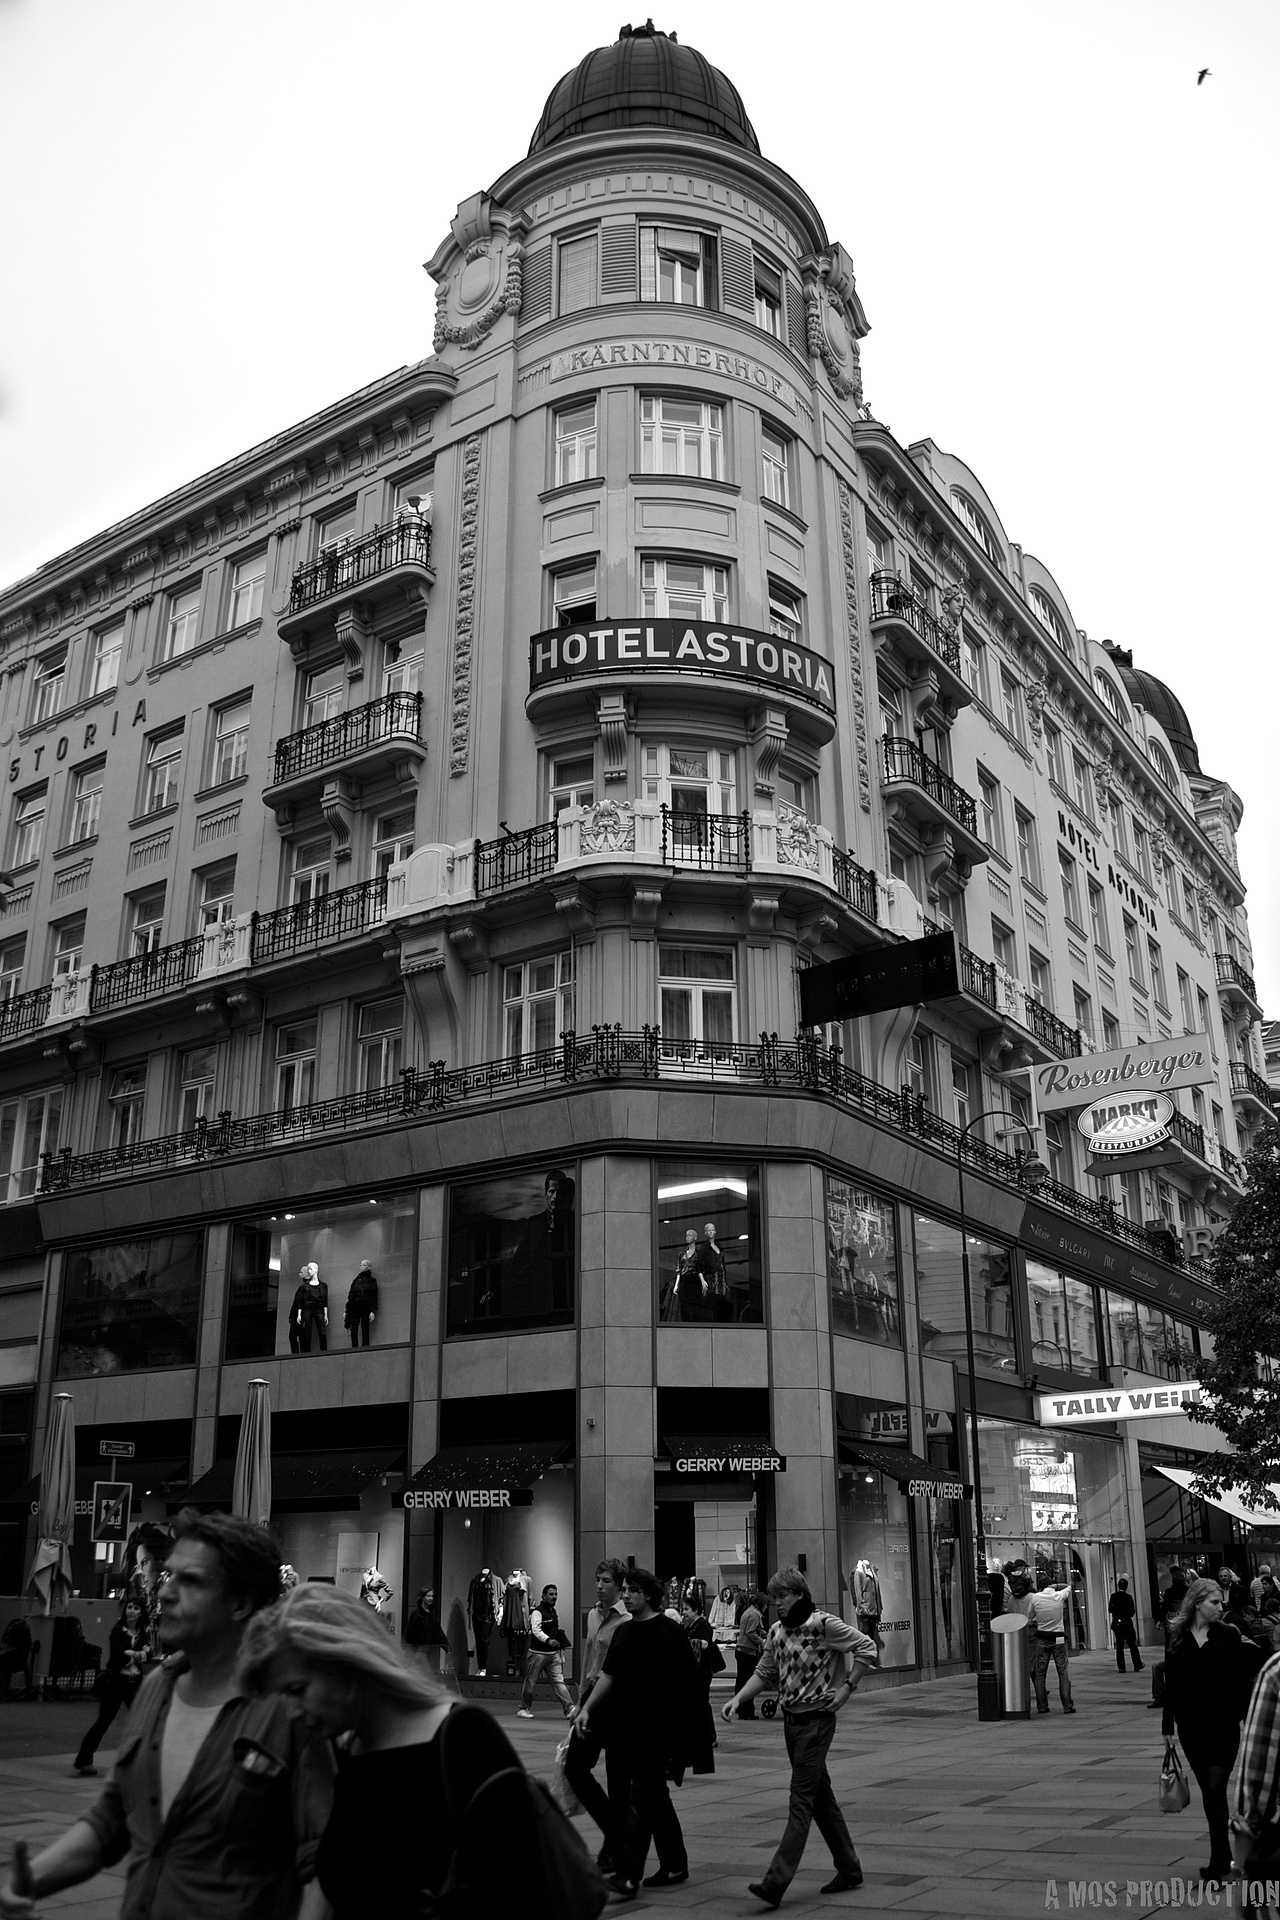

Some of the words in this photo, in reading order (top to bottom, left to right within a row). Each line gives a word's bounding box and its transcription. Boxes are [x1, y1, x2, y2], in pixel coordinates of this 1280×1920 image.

[570, 340, 783, 395] KÄRNTNERHOF
[535, 627, 670, 674] HOTEL
[675, 629, 832, 700] ASTORIA
[1108, 863, 1158, 931] ASTORIA
[1038, 1050, 1206, 1095] Rosenberger
[1091, 1098, 1159, 1133] MARKT
[1094, 1129, 1163, 1150] RESTAURANT
[1053, 1396, 1122, 1417] TALLY
[676, 1457, 726, 1472] GERRY
[728, 1457, 781, 1472] WEBER
[403, 1490, 452, 1509] GERRY
[455, 1489, 511, 1508] WEBER
[908, 1479, 936, 1497] GERRY
[937, 1481, 964, 1499] WEBER
[877, 1622, 893, 1632] GERRY
[894, 1620, 911, 1631] WEBER
